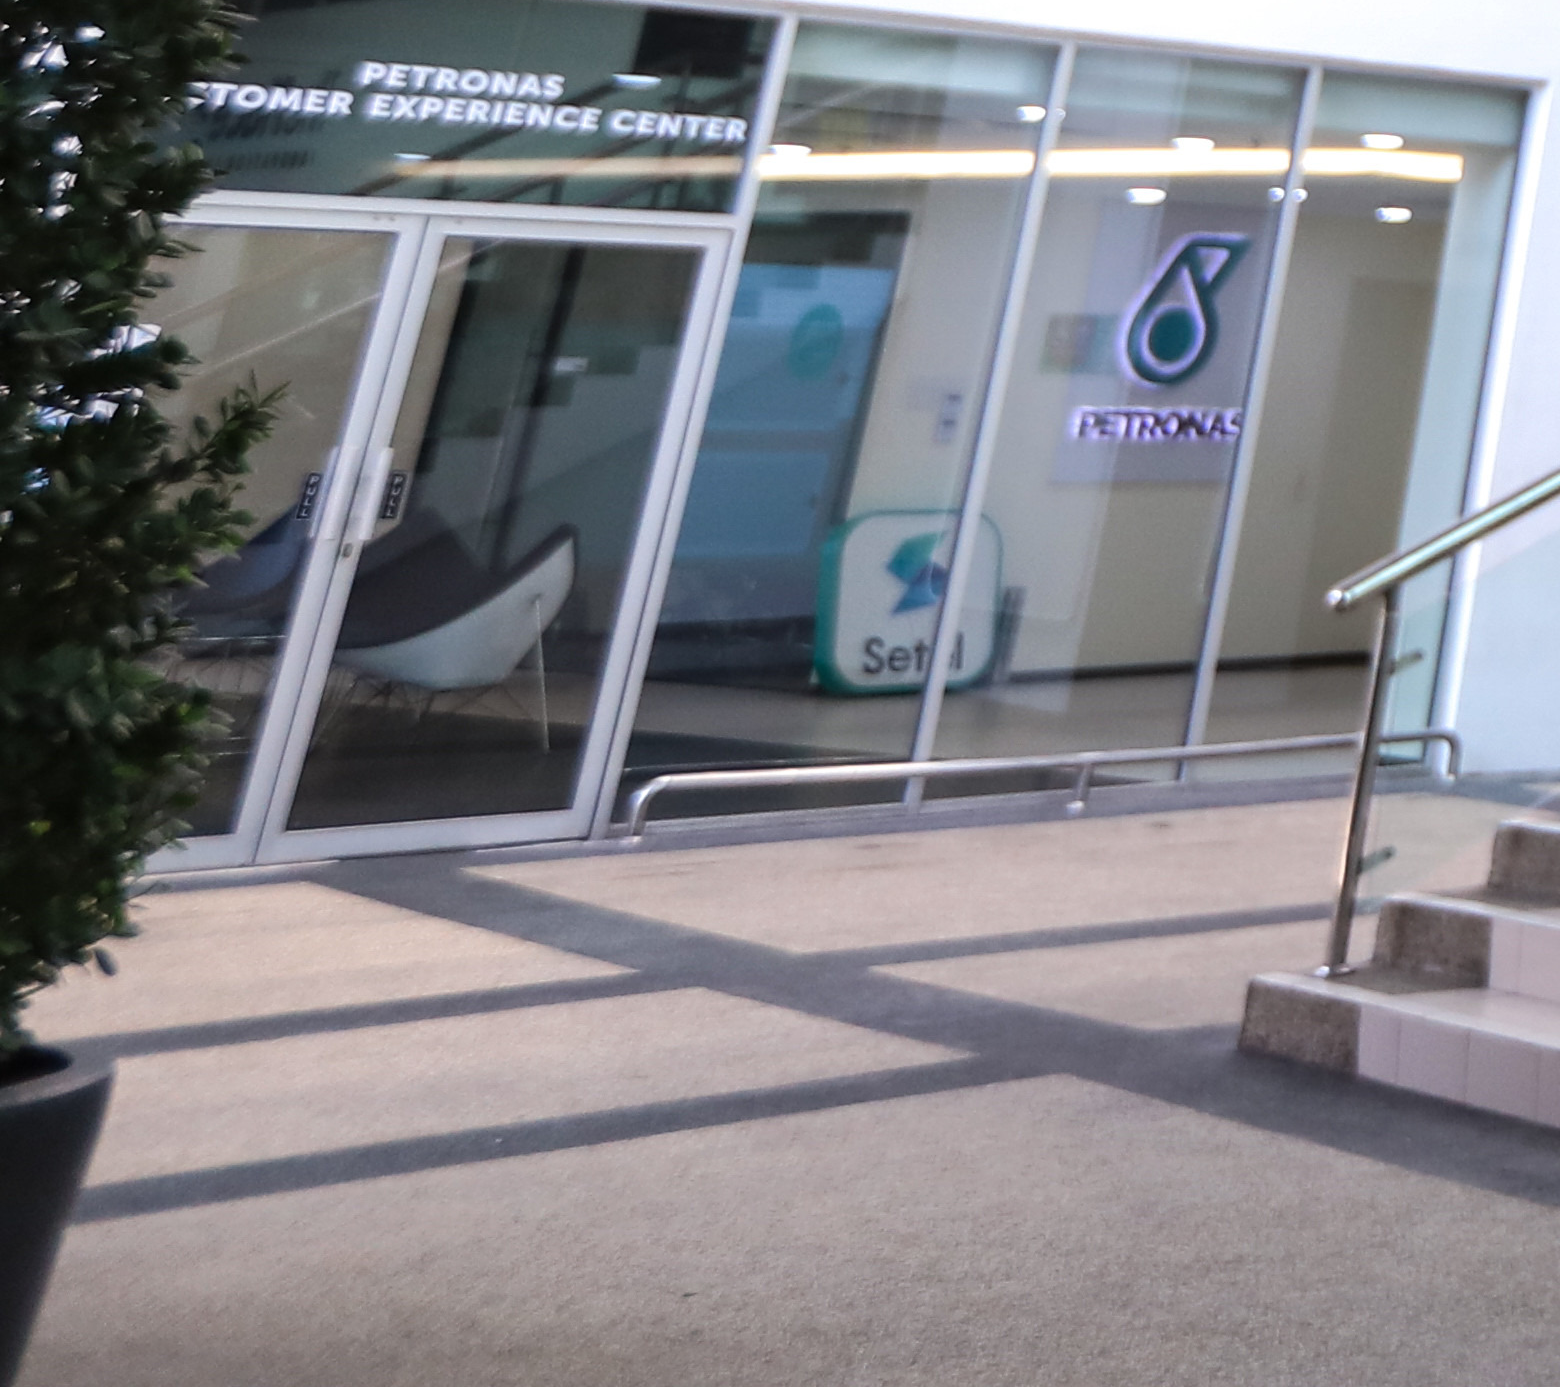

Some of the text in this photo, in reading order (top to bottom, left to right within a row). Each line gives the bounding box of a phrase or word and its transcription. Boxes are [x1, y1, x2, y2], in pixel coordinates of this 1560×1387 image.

[358, 60, 566, 99] PETRONAS
[186, 80, 749, 143] STOMER EXPERIENCE CENTER
[1070, 405, 1241, 441] PETRONAS
[300, 474, 320, 517] PULL
[385, 474, 403, 517] PULL
[862, 631, 964, 675] Setl
